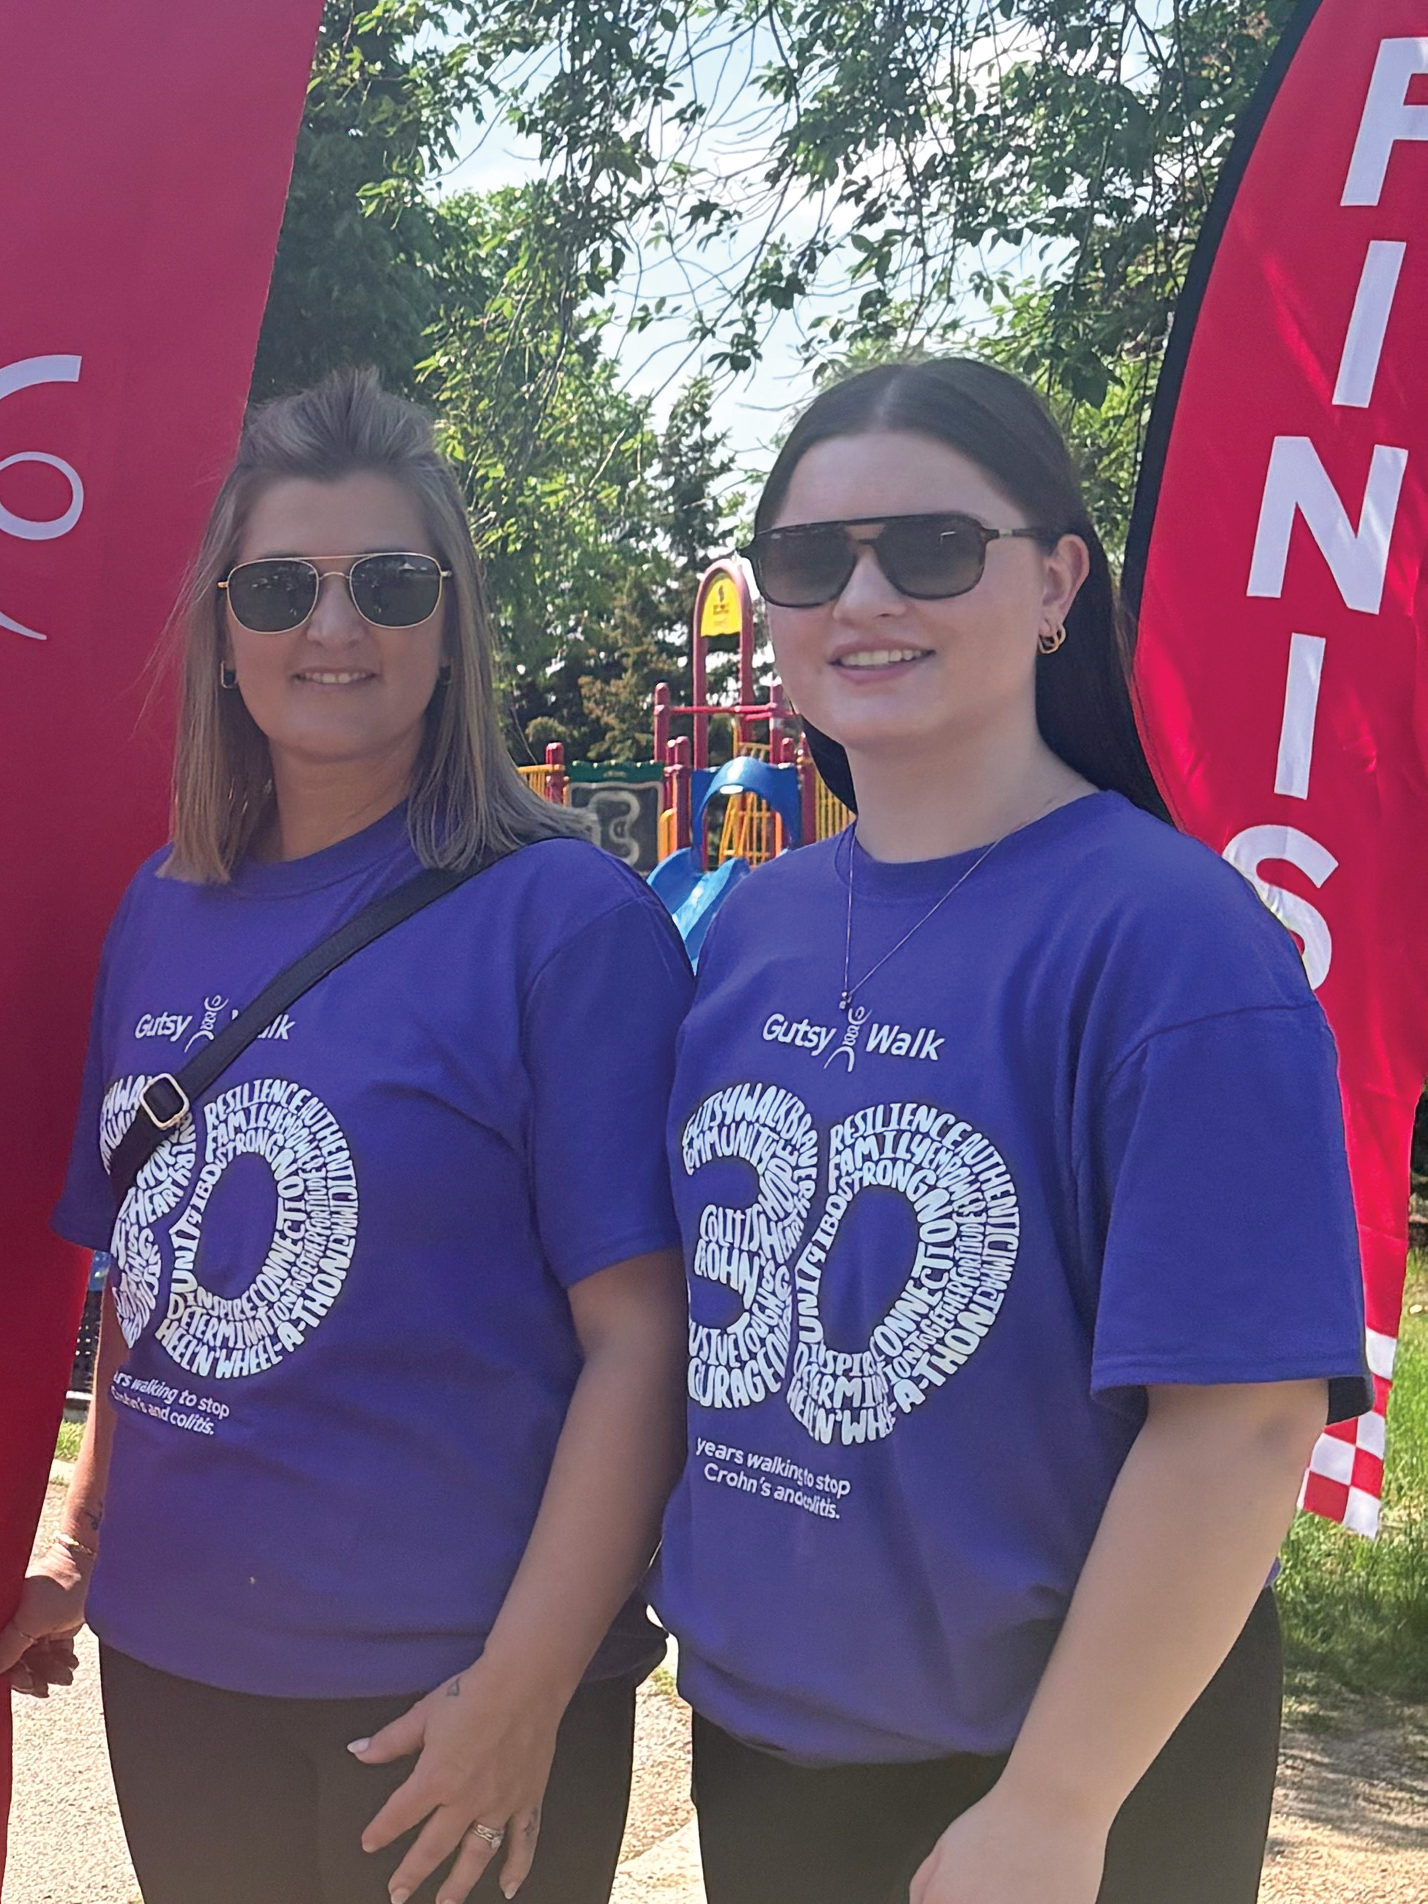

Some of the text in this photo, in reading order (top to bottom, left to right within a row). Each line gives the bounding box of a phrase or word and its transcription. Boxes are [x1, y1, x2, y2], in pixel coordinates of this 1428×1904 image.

[1222, 37, 1428, 990] FINIS
[135, 1011, 192, 1042] Gutsy
[762, 1013, 945, 1061] Gutsy Walk
[204, 1079, 311, 1129] RESILIENCE
[734, 1083, 799, 1132] WALK
[204, 1103, 284, 1163] FAMILY
[216, 1127, 285, 1170] STRONG
[828, 1130, 932, 1194] FAMILY
[829, 1103, 973, 1155] RESILIENCE
[953, 1132, 1020, 1252] AUTHENTIC
[169, 1163, 223, 1293] UNITY IBD
[249, 1148, 307, 1307] CONNECTION
[700, 1203, 764, 1252] COLITIS
[795, 1242, 827, 1343] UNITY
[869, 1187, 959, 1362] CONNECTION
[131, 1378, 178, 1405] walking
[179, 1390, 197, 1407] to
[198, 1397, 230, 1420] stop
[170, 1411, 215, 1435] colitis.
[696, 1436, 744, 1465] years
[803, 1467, 814, 1487] to
[815, 1474, 852, 1500] stop
[704, 1462, 771, 1497] Crohn's
